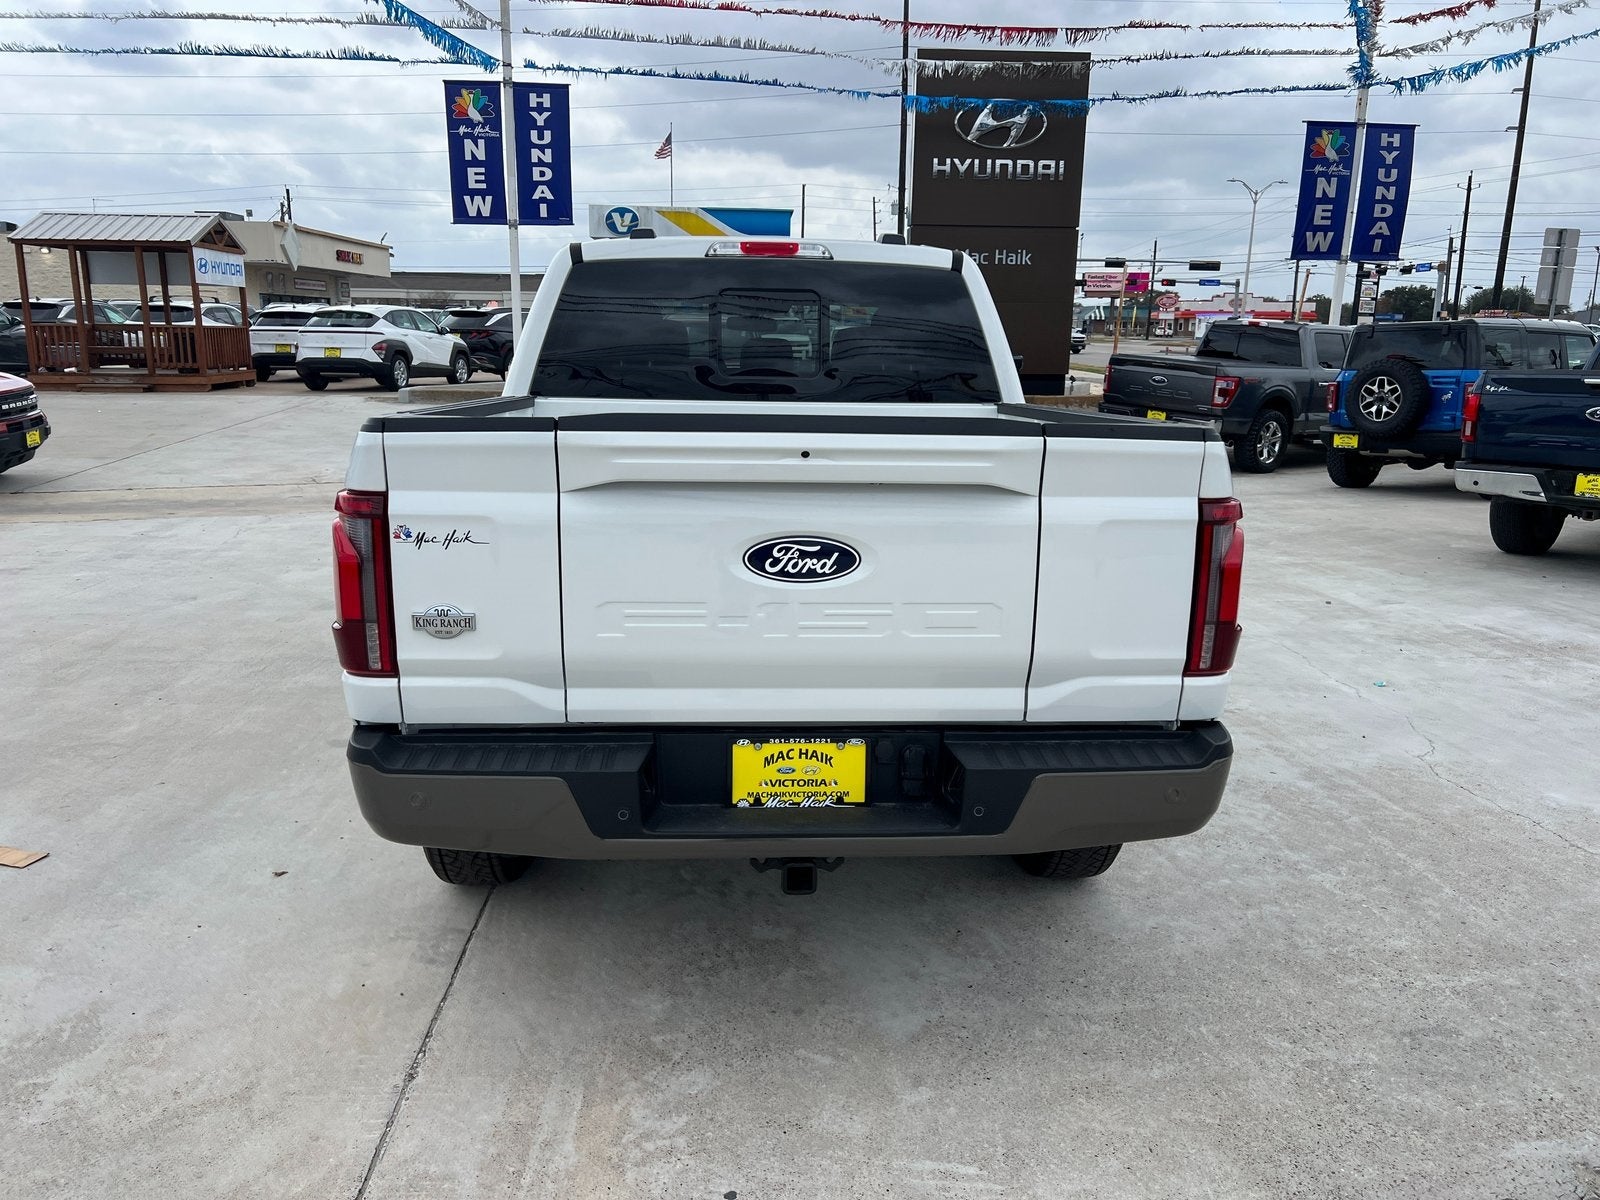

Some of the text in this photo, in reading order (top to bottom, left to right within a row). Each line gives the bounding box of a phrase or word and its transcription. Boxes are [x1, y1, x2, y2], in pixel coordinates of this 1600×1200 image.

[528, 92, 555, 218] HYUNDAI
[463, 138, 493, 217] NEW
[932, 157, 1065, 181] HYUNDAI
[1368, 132, 1401, 253] HYUNDAI
[1305, 177, 1338, 253] NEW
[995, 249, 1032, 265] Haik
[210, 260, 244, 277] HYUNDAI
[2, 397, 38, 410] BRONCO
[412, 529, 485, 550] Mac Haik
[765, 542, 839, 574] Ford
[415, 616, 471, 628] KING RANCH
[763, 748, 834, 768] MAC HAIK
[769, 778, 828, 788] VICTORIA
[747, 790, 850, 799] MACHAIKVICTORIA.COM
[763, 795, 844, 808] Mac Haik
